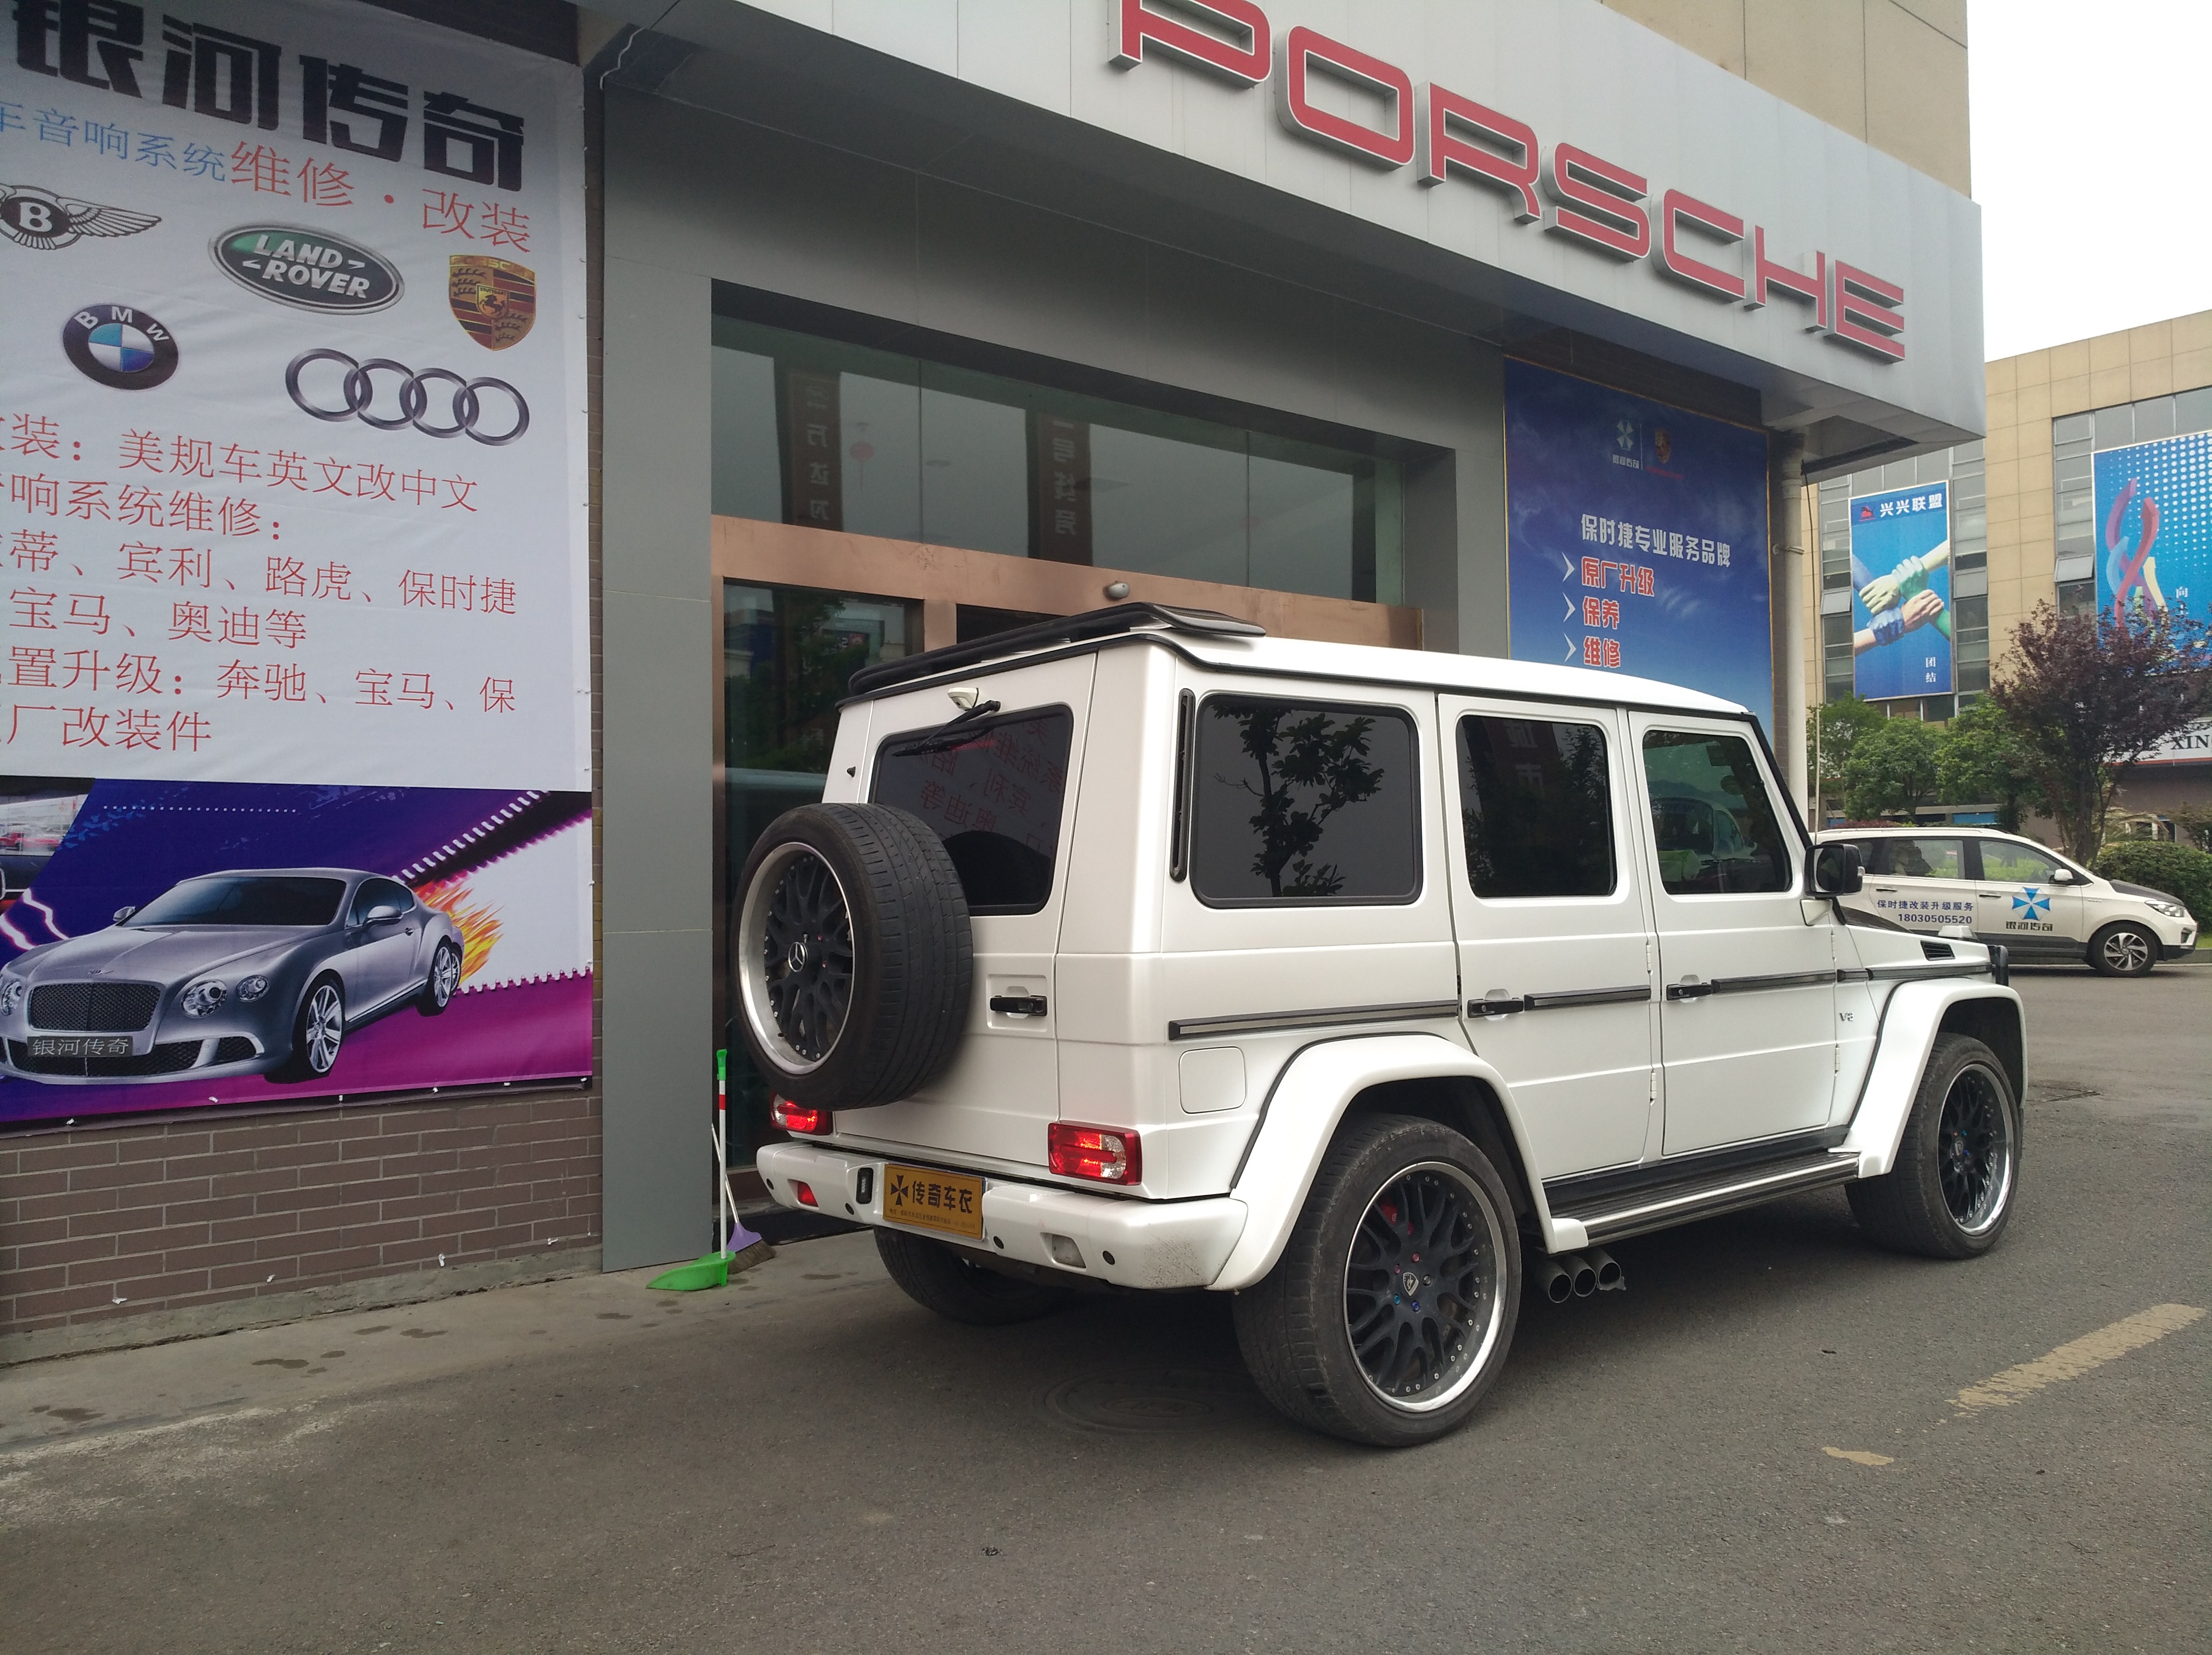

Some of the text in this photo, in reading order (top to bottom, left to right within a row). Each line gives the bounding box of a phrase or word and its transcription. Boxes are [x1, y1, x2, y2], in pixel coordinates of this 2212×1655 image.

[12, 0, 524, 192] 银河传奇
[1109, 0, 1906, 363] PORSCHE
[19, 202, 53, 232] B
[254, 234, 343, 268] LAND
[262, 260, 370, 299] ROVER
[74, 306, 170, 341] BMW
[0, 473, 280, 541] 响系统维修：
[1880, 493, 1943, 517] 兴兴联盟
[1581, 514, 1731, 568] 保时捷专业服务品牌
[1581, 556, 1655, 597] 原厂升级
[1582, 596, 1621, 630] 保养
[1583, 636, 1622, 668] 维修
[1926, 656, 1937, 683] 团结
[1877, 900, 1974, 911] 保时捷改装升级服务
[1898, 913, 1972, 924] 18030505520
[2005, 921, 2053, 932] 银河传奇
[32, 1038, 129, 1055] 银河传奇
[912, 1180, 973, 1214] 传奇车衣
